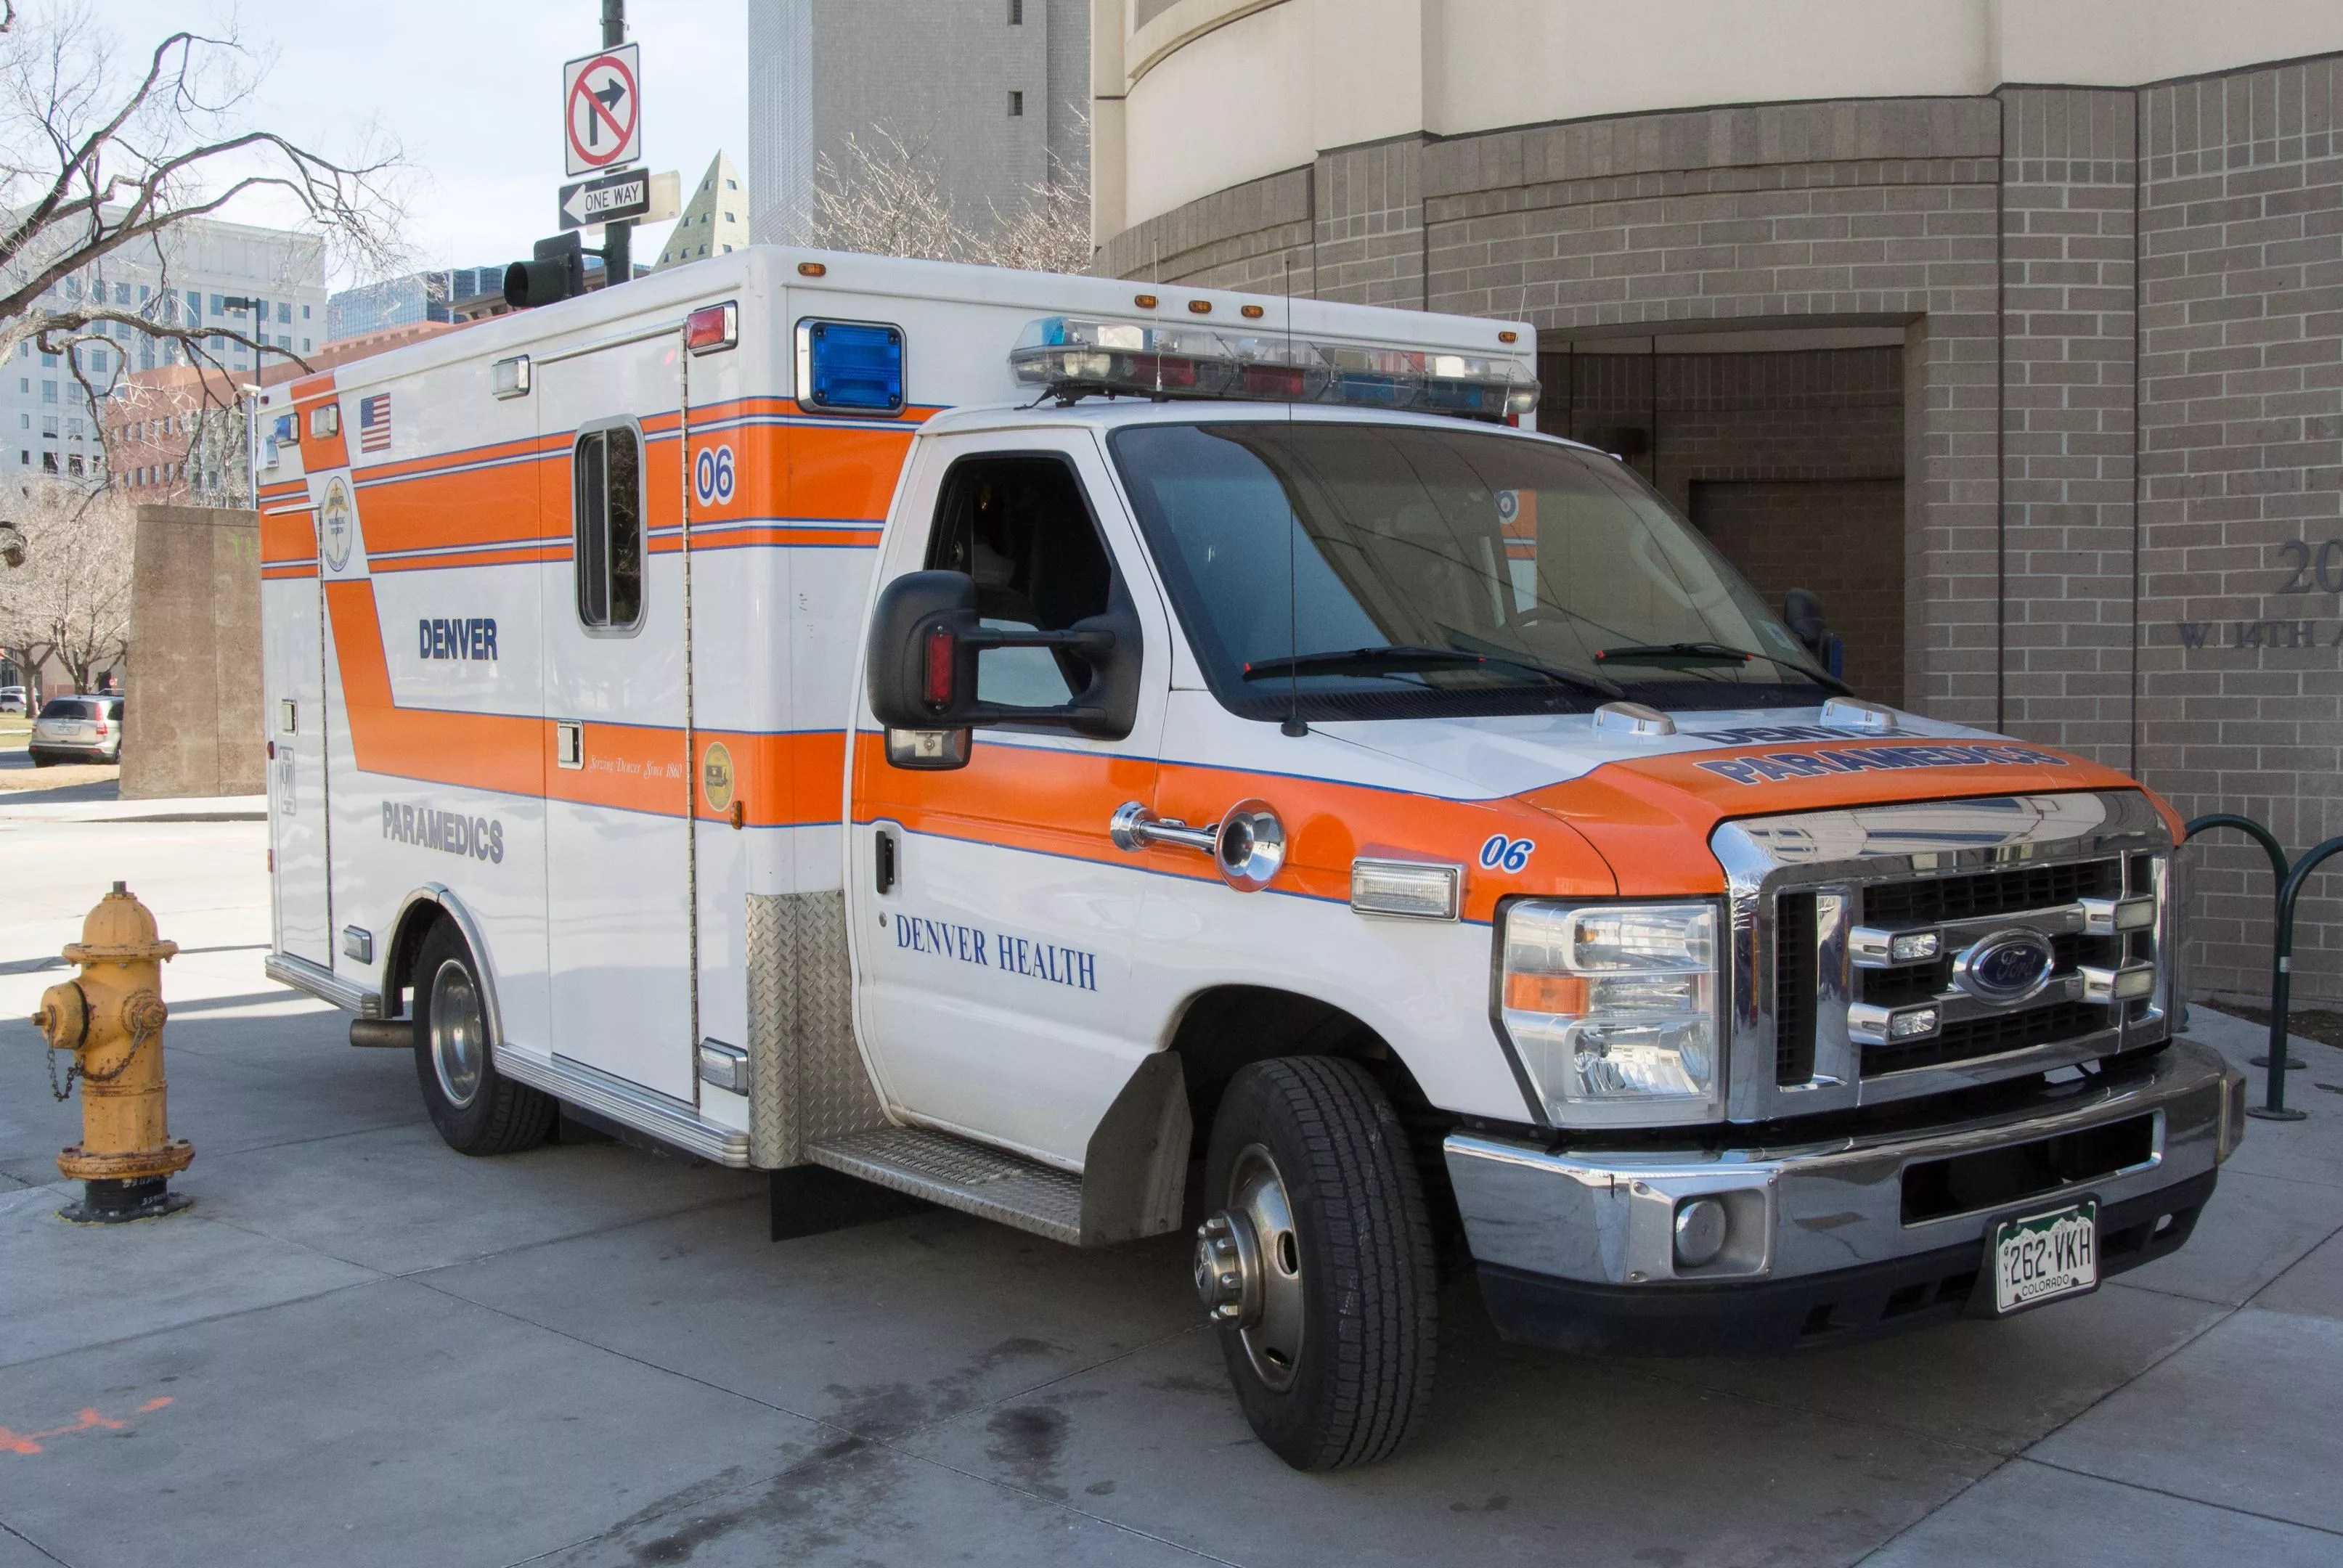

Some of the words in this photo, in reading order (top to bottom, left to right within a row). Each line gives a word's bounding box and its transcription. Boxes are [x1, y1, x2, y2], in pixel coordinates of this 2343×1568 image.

[585, 191, 610, 211] ONE
[614, 184, 639, 205] WAY
[696, 446, 734, 504] 06
[2276, 539, 2343, 594] 20
[419, 618, 498, 660] DENVER
[2178, 622, 2213, 649] W
[2234, 621, 2316, 649] 14TH
[616, 757, 641, 773] Denver
[643, 760, 663, 779] Since
[667, 763, 682, 779] 1860
[1693, 746, 2069, 784] PARAMEDICS
[382, 801, 504, 864] PARAMEDICS
[1480, 835, 1534, 873] 06
[895, 913, 988, 966] DENVER
[997, 934, 1097, 992] HEALTH
[1997, 949, 2037, 981] Ford
[2022, 1273, 2069, 1297] COLORADO
